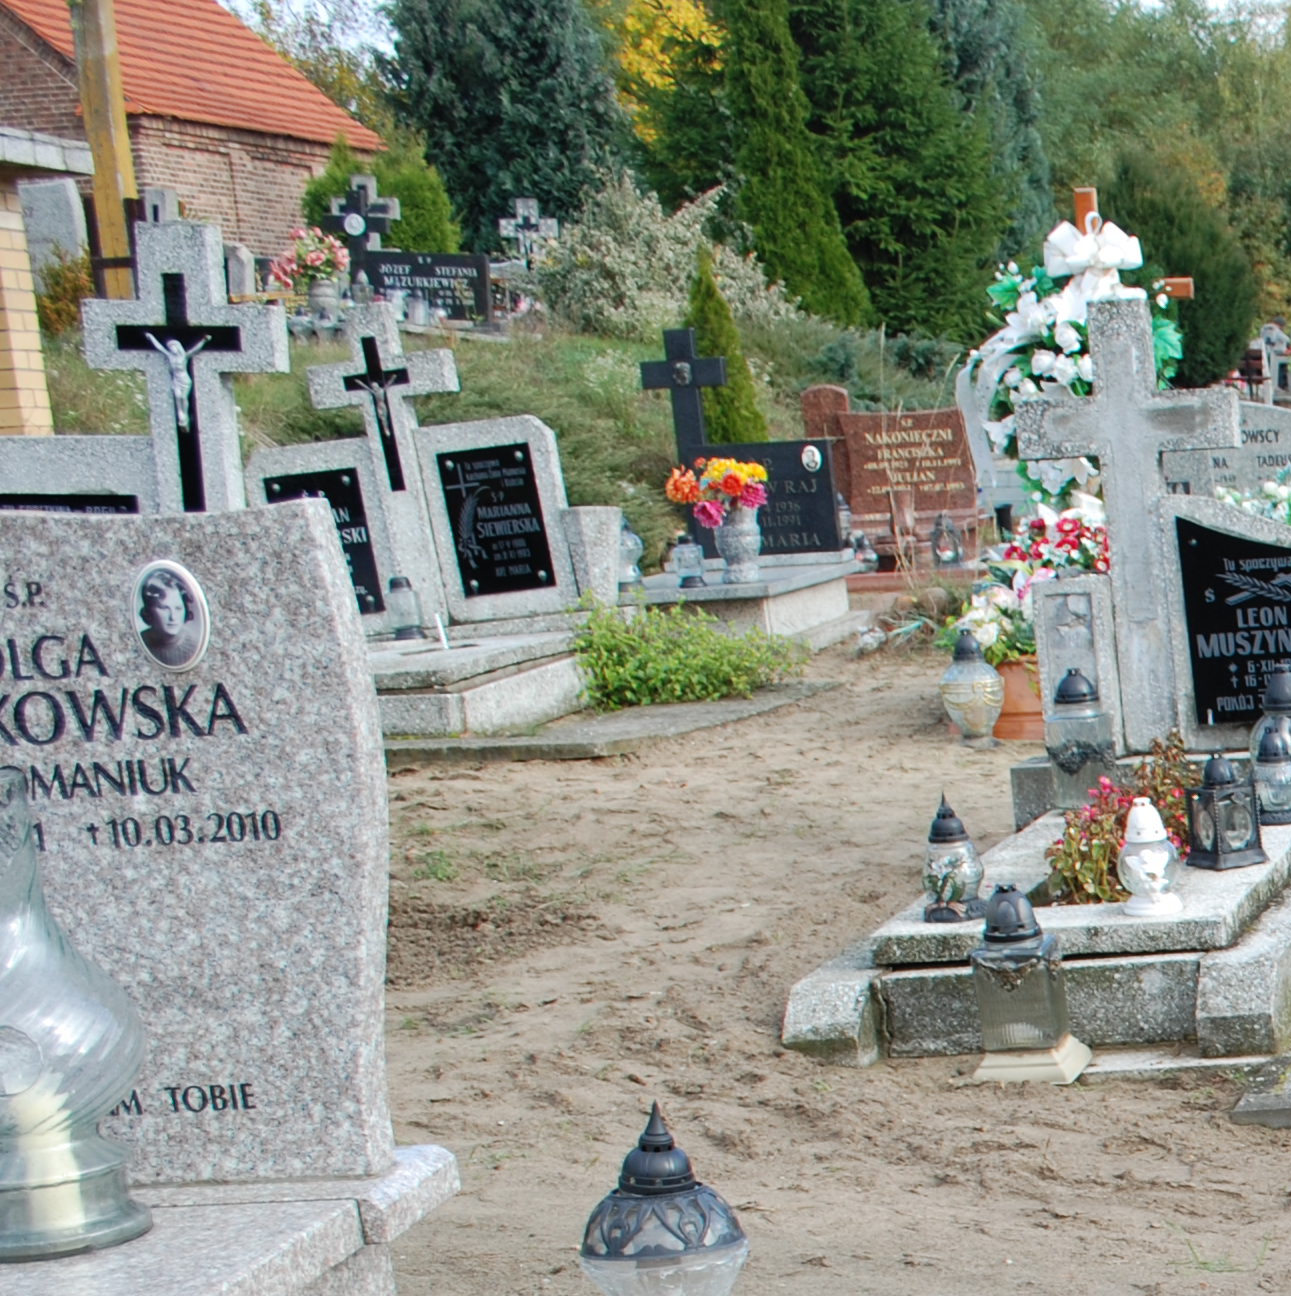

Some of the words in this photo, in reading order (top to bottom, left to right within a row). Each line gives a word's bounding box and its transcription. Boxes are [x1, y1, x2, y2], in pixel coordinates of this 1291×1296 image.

[863, 428, 954, 445] NAKONIECZNI
[785, 479, 818, 495] RAJ
[476, 502, 531, 519] MARIANNA
[476, 516, 541, 539] SIEWIERSKA
[1222, 557, 1237, 572] Tu
[1235, 605, 1290, 630] LEON
[0, 633, 110, 681] LGA
[105, 809, 283, 850] 10.03.2010
[163, 1082, 258, 1113] TOBIE
